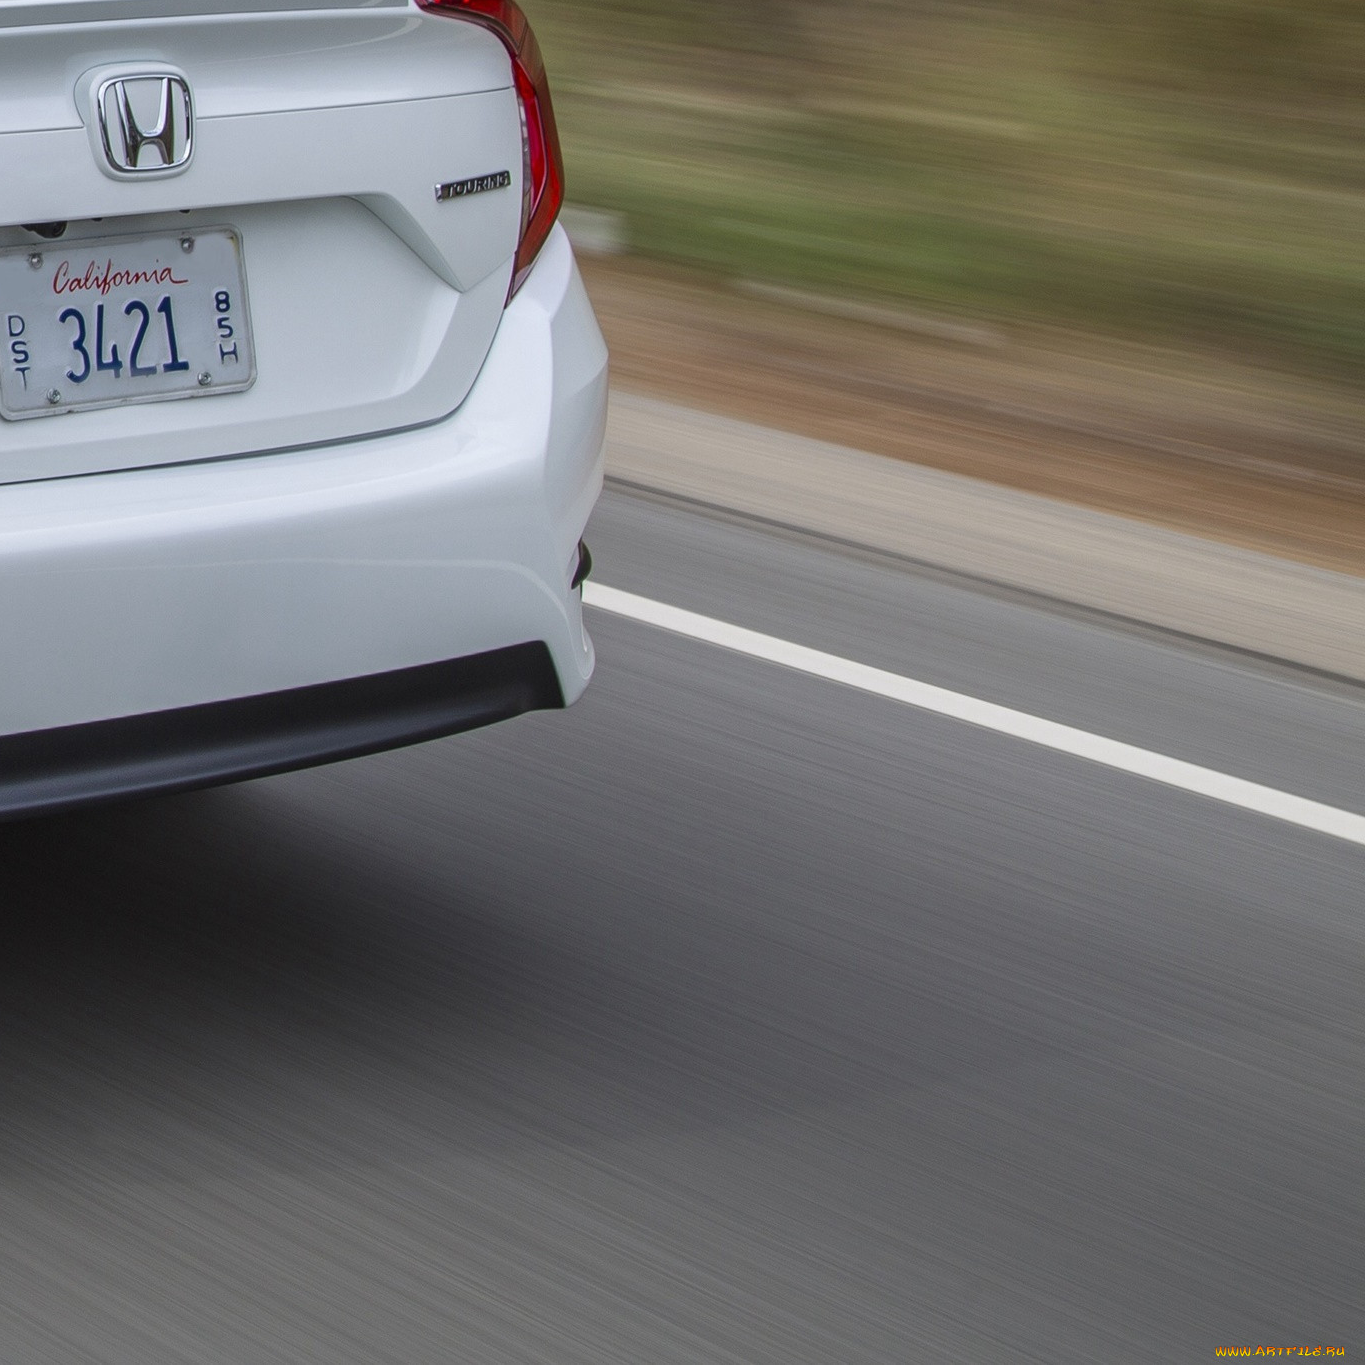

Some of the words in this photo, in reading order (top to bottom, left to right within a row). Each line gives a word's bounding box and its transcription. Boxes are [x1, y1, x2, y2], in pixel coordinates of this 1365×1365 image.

[448, 173, 509, 198] TOURING
[52, 258, 189, 295] California
[59, 295, 190, 384] 3421
